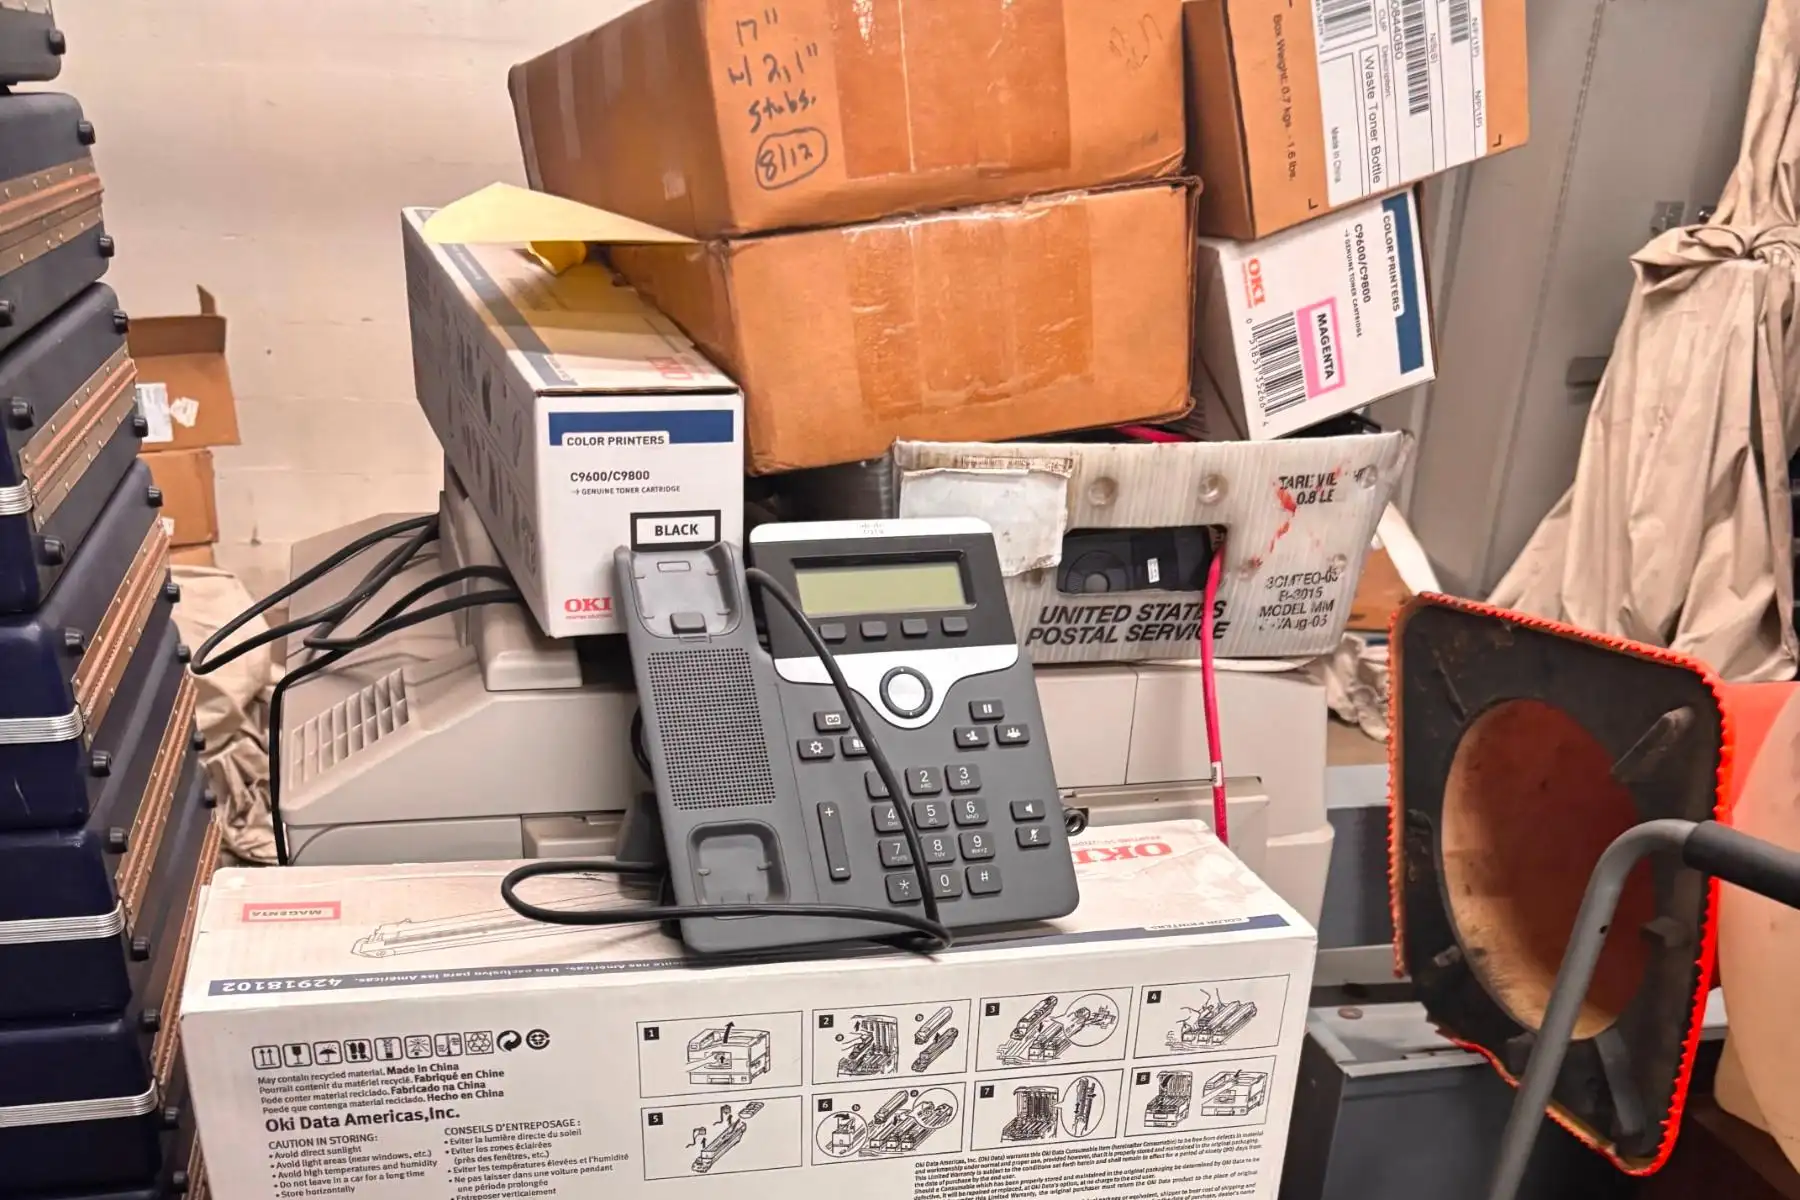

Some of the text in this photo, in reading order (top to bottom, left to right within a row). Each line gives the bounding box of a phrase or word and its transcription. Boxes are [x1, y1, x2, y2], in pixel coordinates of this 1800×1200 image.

[1273, 13, 1283, 38] Box
[1364, 54, 1382, 184] Waste Toner Bottle
[1354, 223, 1371, 303] C9600/C9800
[1383, 215, 1400, 312] COLOR PRINTERS
[1248, 258, 1265, 305] OKI
[1345, 239, 1362, 338] GENUINE TONER CARTRIDGE
[1317, 313, 1335, 380] MAGENTA
[567, 435, 665, 446] COLOR PRINTERS
[570, 470, 650, 482] C9600/C9800
[581, 488, 614, 496] GENUINE
[641, 485, 680, 494] CARTRIDGE
[655, 523, 699, 537] BLACK
[564, 597, 612, 612] OKI
[1259, 602, 1307, 618] MODEL
[1039, 604, 1132, 625] UNITED
[1024, 624, 1119, 646] POSTAL
[919, 770, 929, 783] 2
[959, 767, 969, 780] 3
[886, 808, 896, 821] 4
[926, 804, 936, 817] 5
[966, 801, 976, 814] 6
[933, 839, 943, 852] 8
[973, 835, 983, 848] 9
[892, 843, 901, 855] 7
[1069, 842, 1173, 866] OKI
[940, 874, 950, 887] 0
[222, 978, 343, 992] 42918102
[257, 1077, 276, 1085] May
[277, 1074, 310, 1083] contain
[311, 1071, 346, 1081] recycled
[386, 1065, 416, 1075] Made
[417, 1064, 428, 1073] in
[429, 1062, 460, 1072] China
[414, 1070, 505, 1083] Fabriqué en Chine
[390, 1081, 486, 1095] Fabricado na China
[426, 1090, 505, 1102] Hecho en China
[265, 1107, 460, 1132] Oki Data Americas,Inc.
[444, 1118, 576, 1136] CONSEILS D'ENTREPOSAGE
[268, 1133, 378, 1150] CAUTION IN STORING:
[272, 1145, 362, 1159] Avoid direct sunlight
[276, 1159, 301, 1169] Avoid
[302, 1158, 322, 1167] light
[279, 1185, 355, 1198] Store horizontally
[501, 1188, 556, 1198] verticalement
